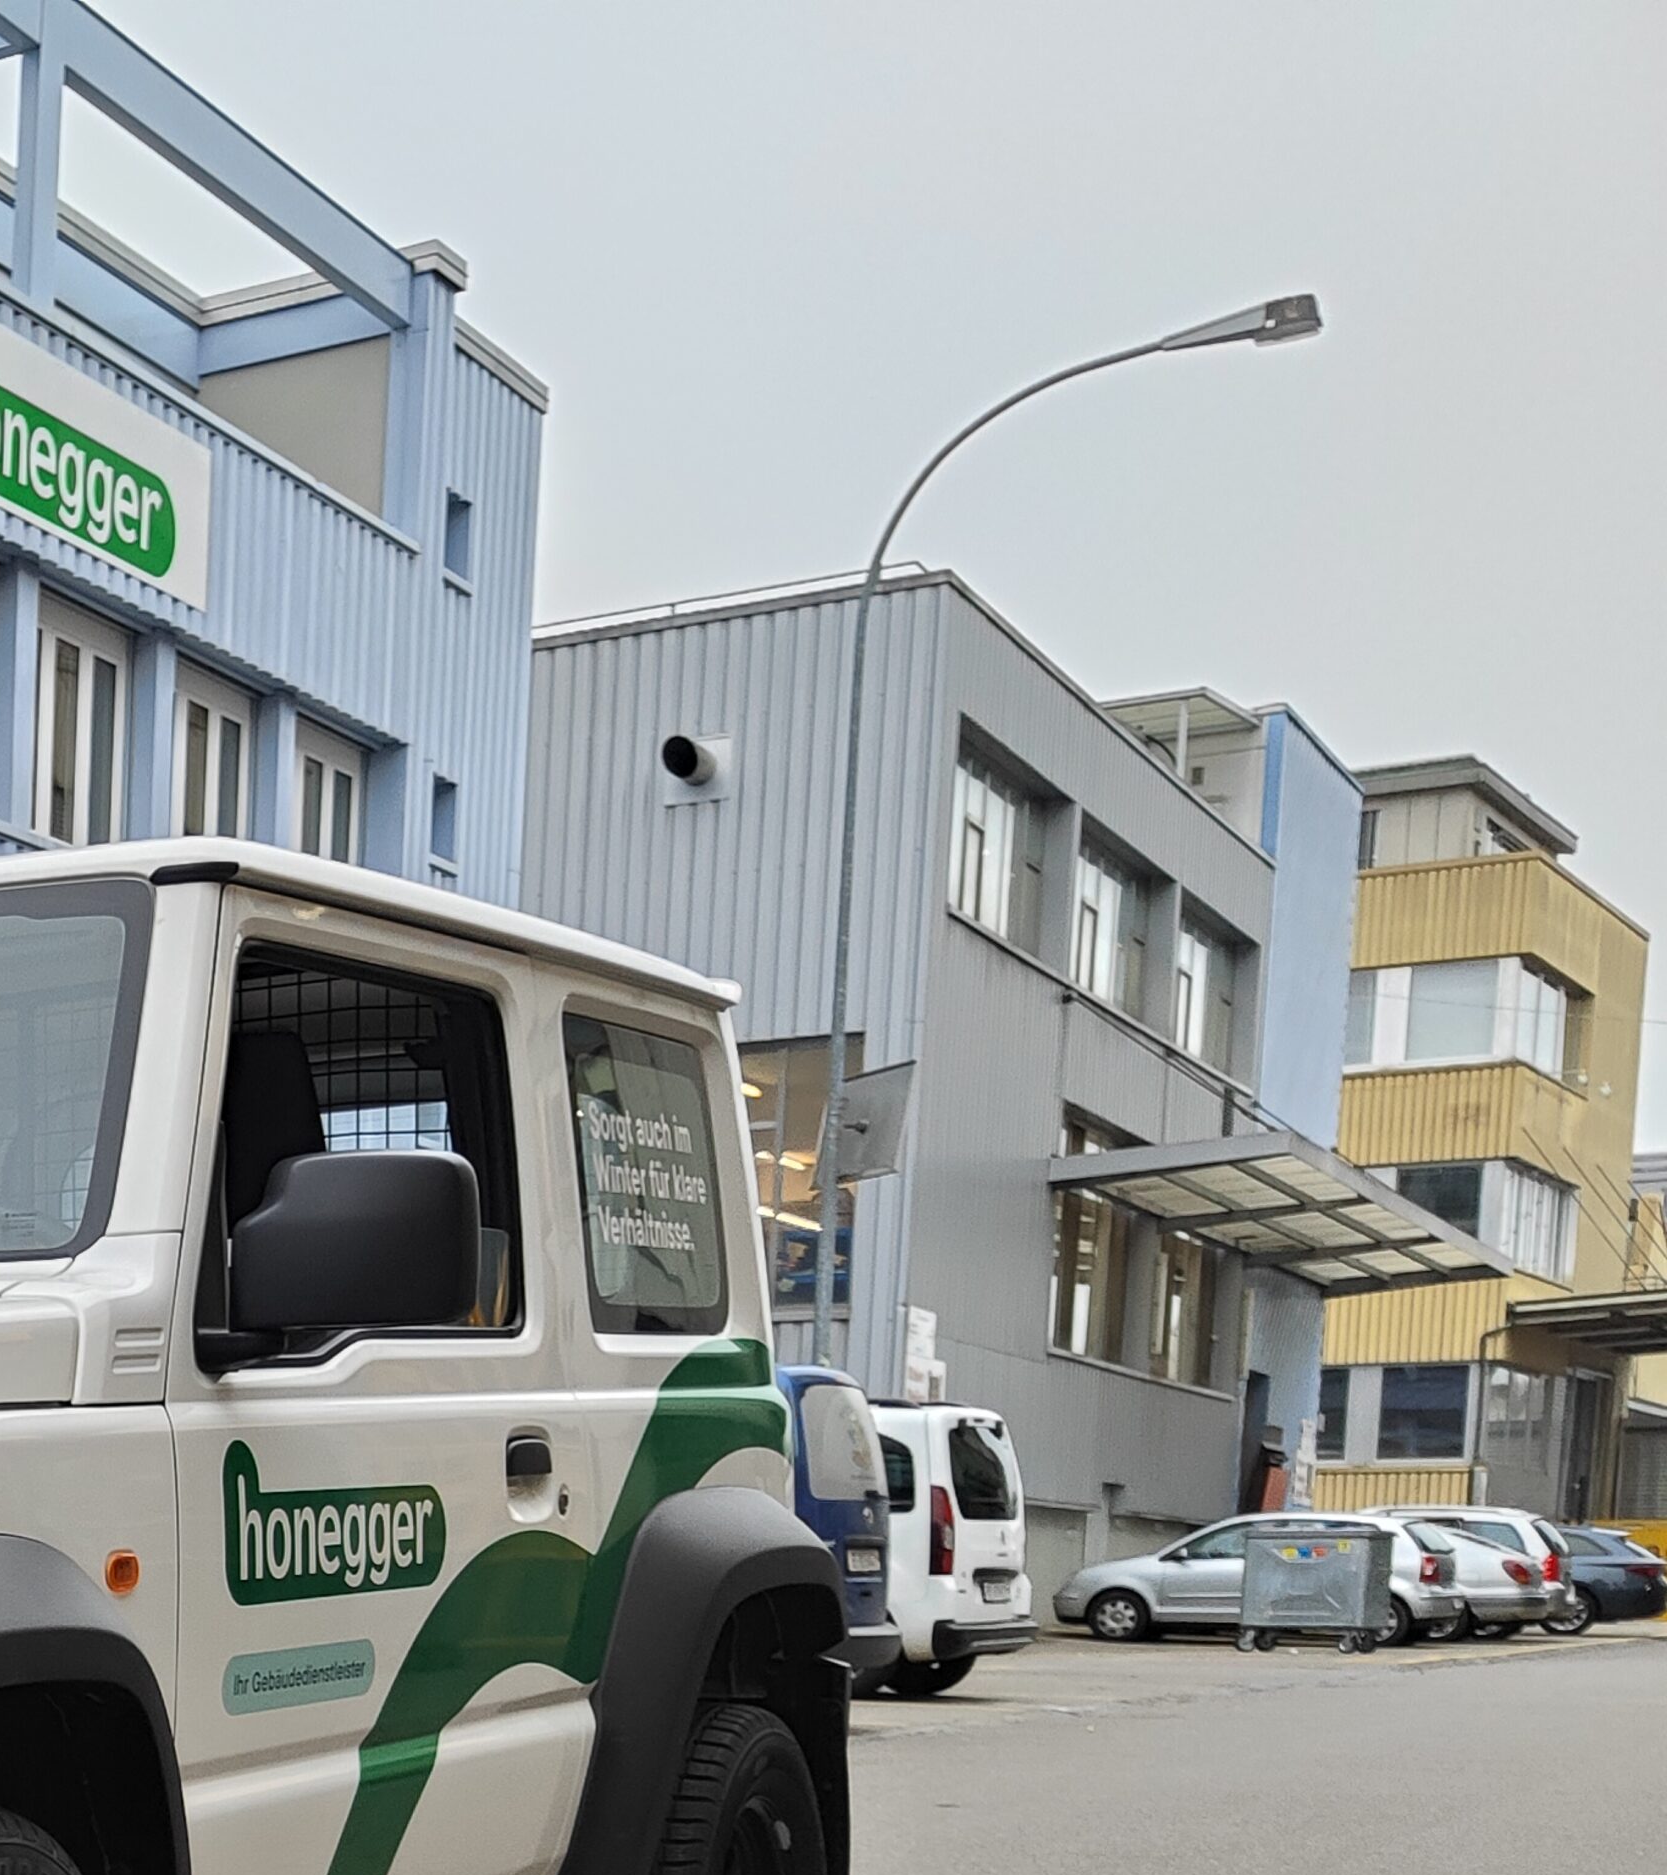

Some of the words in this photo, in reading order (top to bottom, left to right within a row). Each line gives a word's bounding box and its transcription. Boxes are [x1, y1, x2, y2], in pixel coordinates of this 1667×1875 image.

[588, 1102, 634, 1152] Sorgt
[635, 1114, 672, 1151] auch
[672, 1114, 692, 1154] im
[595, 1152, 646, 1198] Winter
[648, 1158, 671, 1200] für
[672, 1166, 707, 1206] klare
[598, 1206, 696, 1251] Verhältnisse.
[238, 1475, 433, 1587] honegger
[233, 1674, 250, 1696] Ihr
[252, 1658, 366, 1694] Gebäudedienstleister
